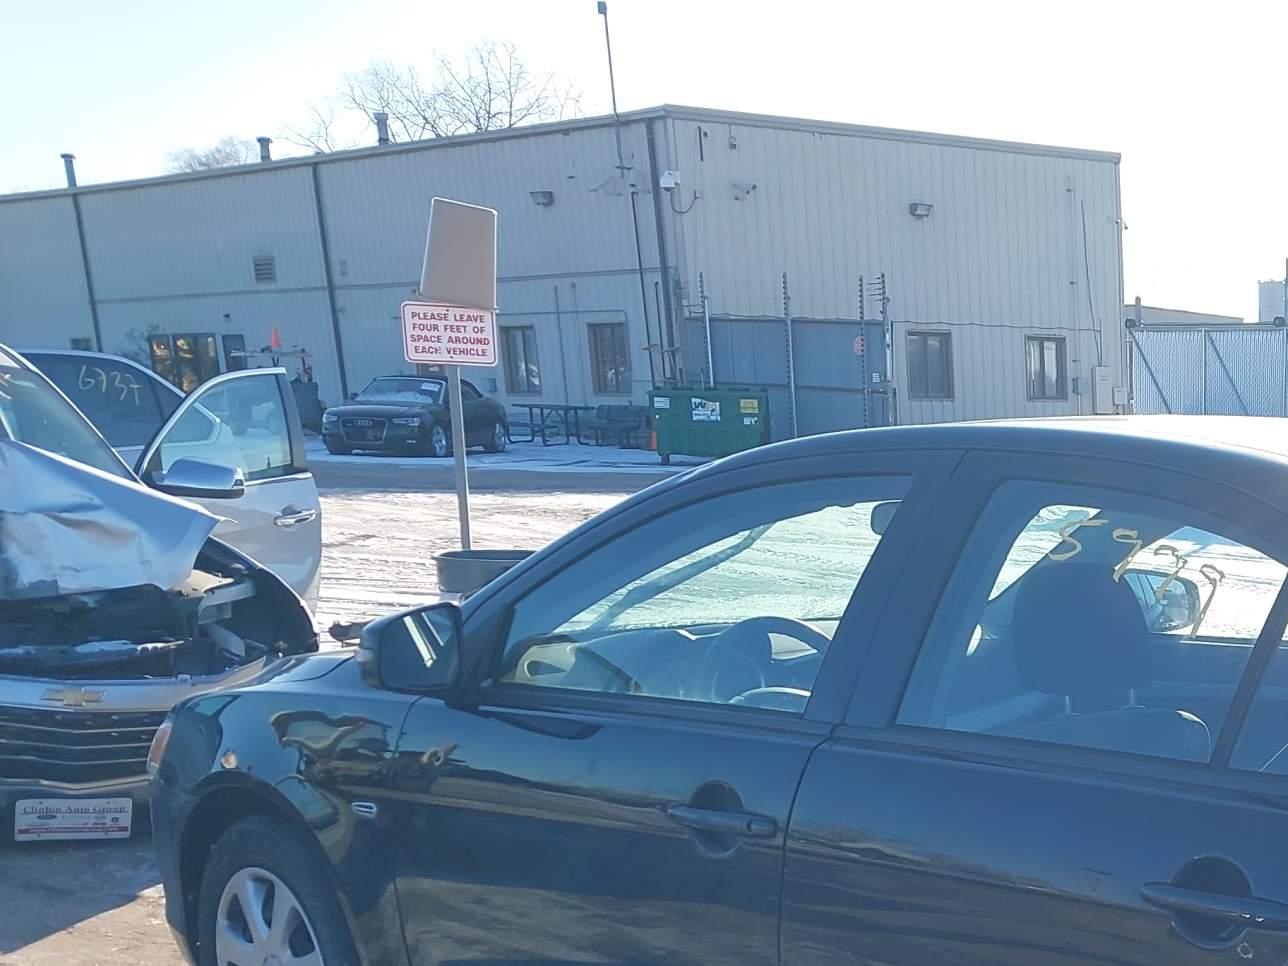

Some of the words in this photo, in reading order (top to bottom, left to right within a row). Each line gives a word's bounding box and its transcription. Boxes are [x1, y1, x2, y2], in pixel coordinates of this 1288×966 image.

[411, 312, 449, 322] PLEASE
[453, 314, 486, 323] LEAVE
[412, 323, 440, 332] FOUR
[444, 325, 467, 334] FEET
[472, 326, 486, 335] OF
[410, 334, 443, 344] SPACE
[447, 336, 490, 346] AROUND
[414, 346, 441, 355] EACH
[446, 347, 488, 357] VEHICLE
[78, 364, 142, 406] 6737
[64, 806, 90, 815] Auto
